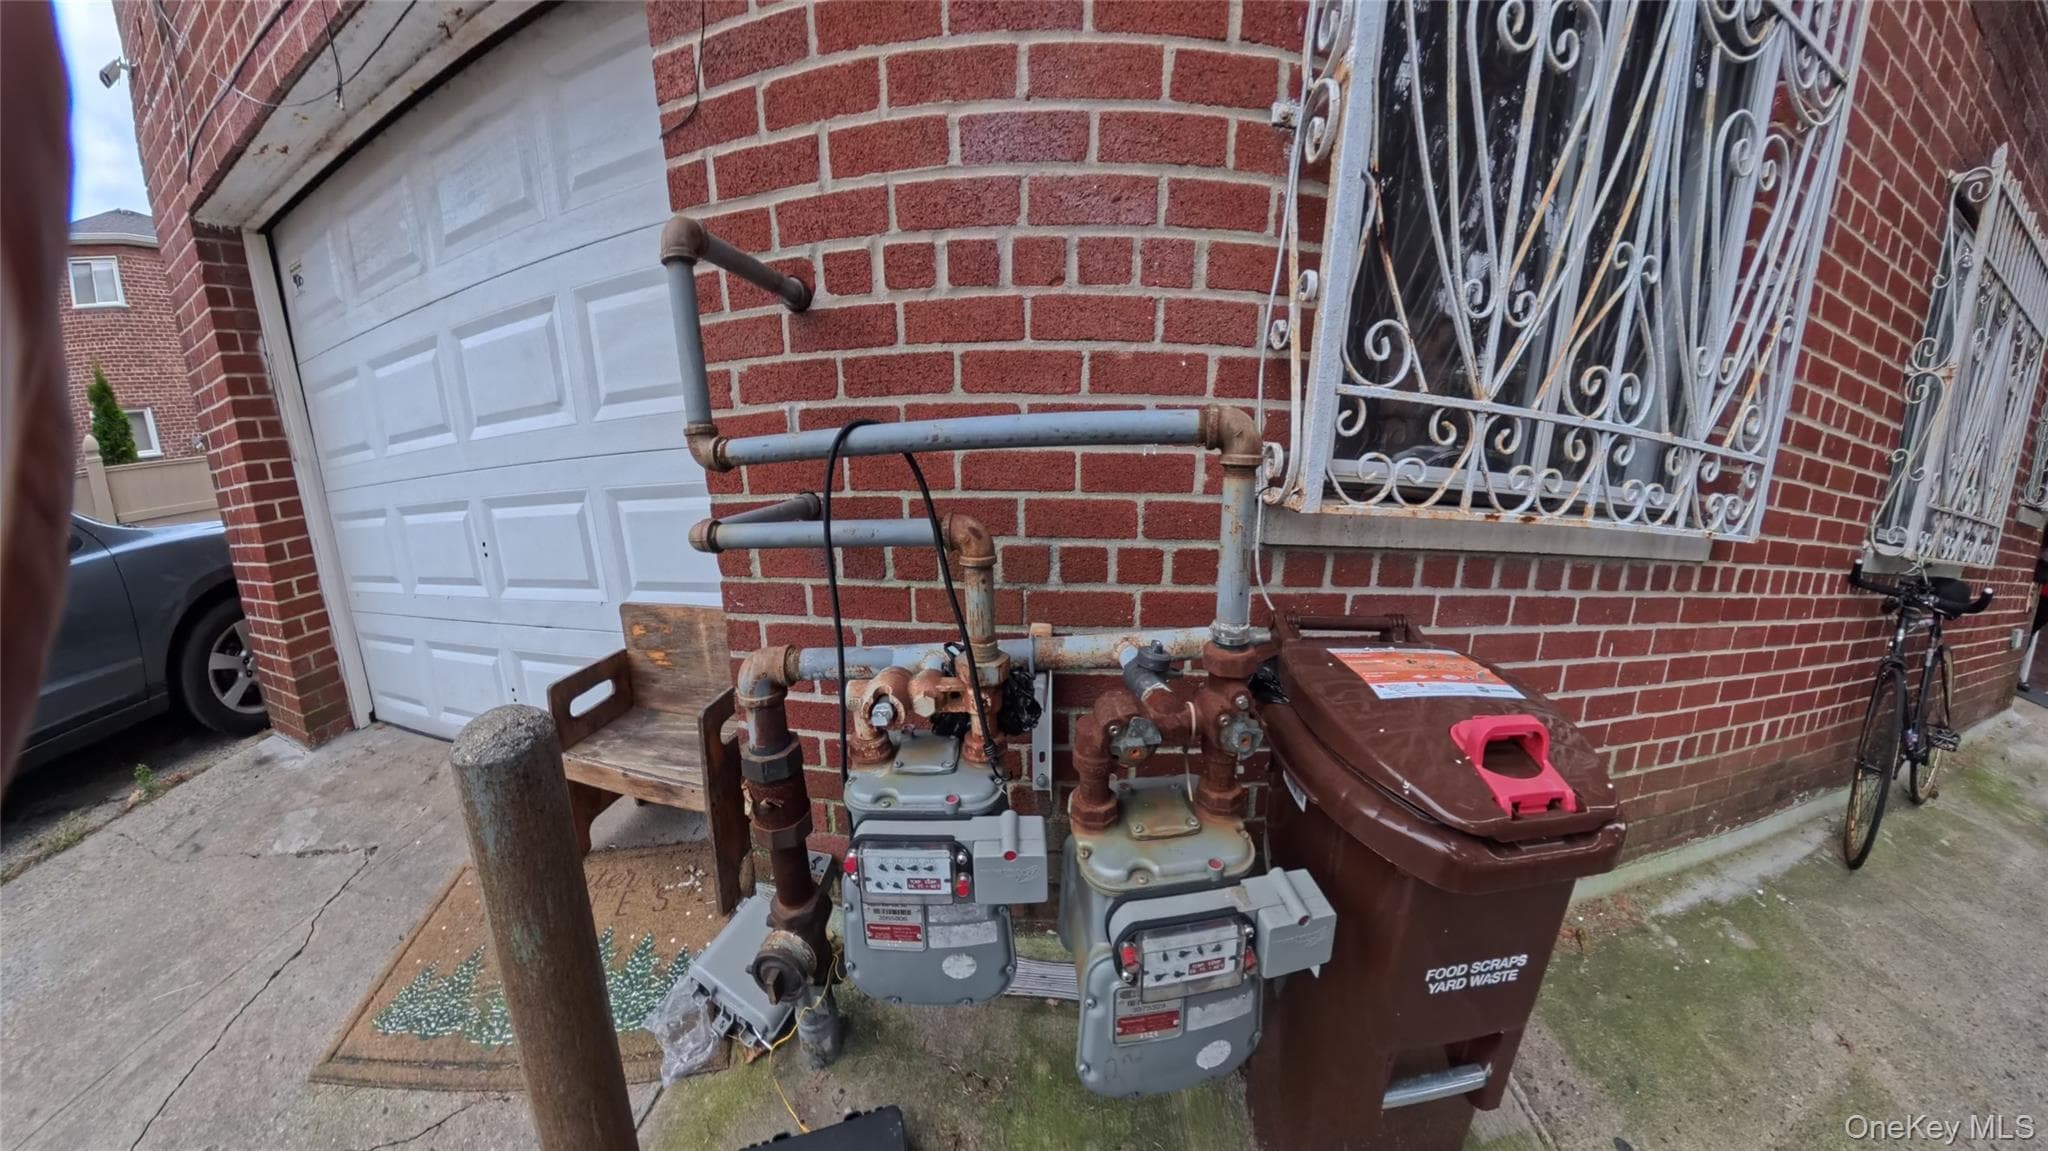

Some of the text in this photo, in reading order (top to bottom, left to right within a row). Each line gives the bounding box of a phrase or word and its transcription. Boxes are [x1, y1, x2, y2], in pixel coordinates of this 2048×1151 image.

[1425, 954, 1529, 982] FOOD SCRAPS
[1428, 969, 1519, 994] YARD WASTE
